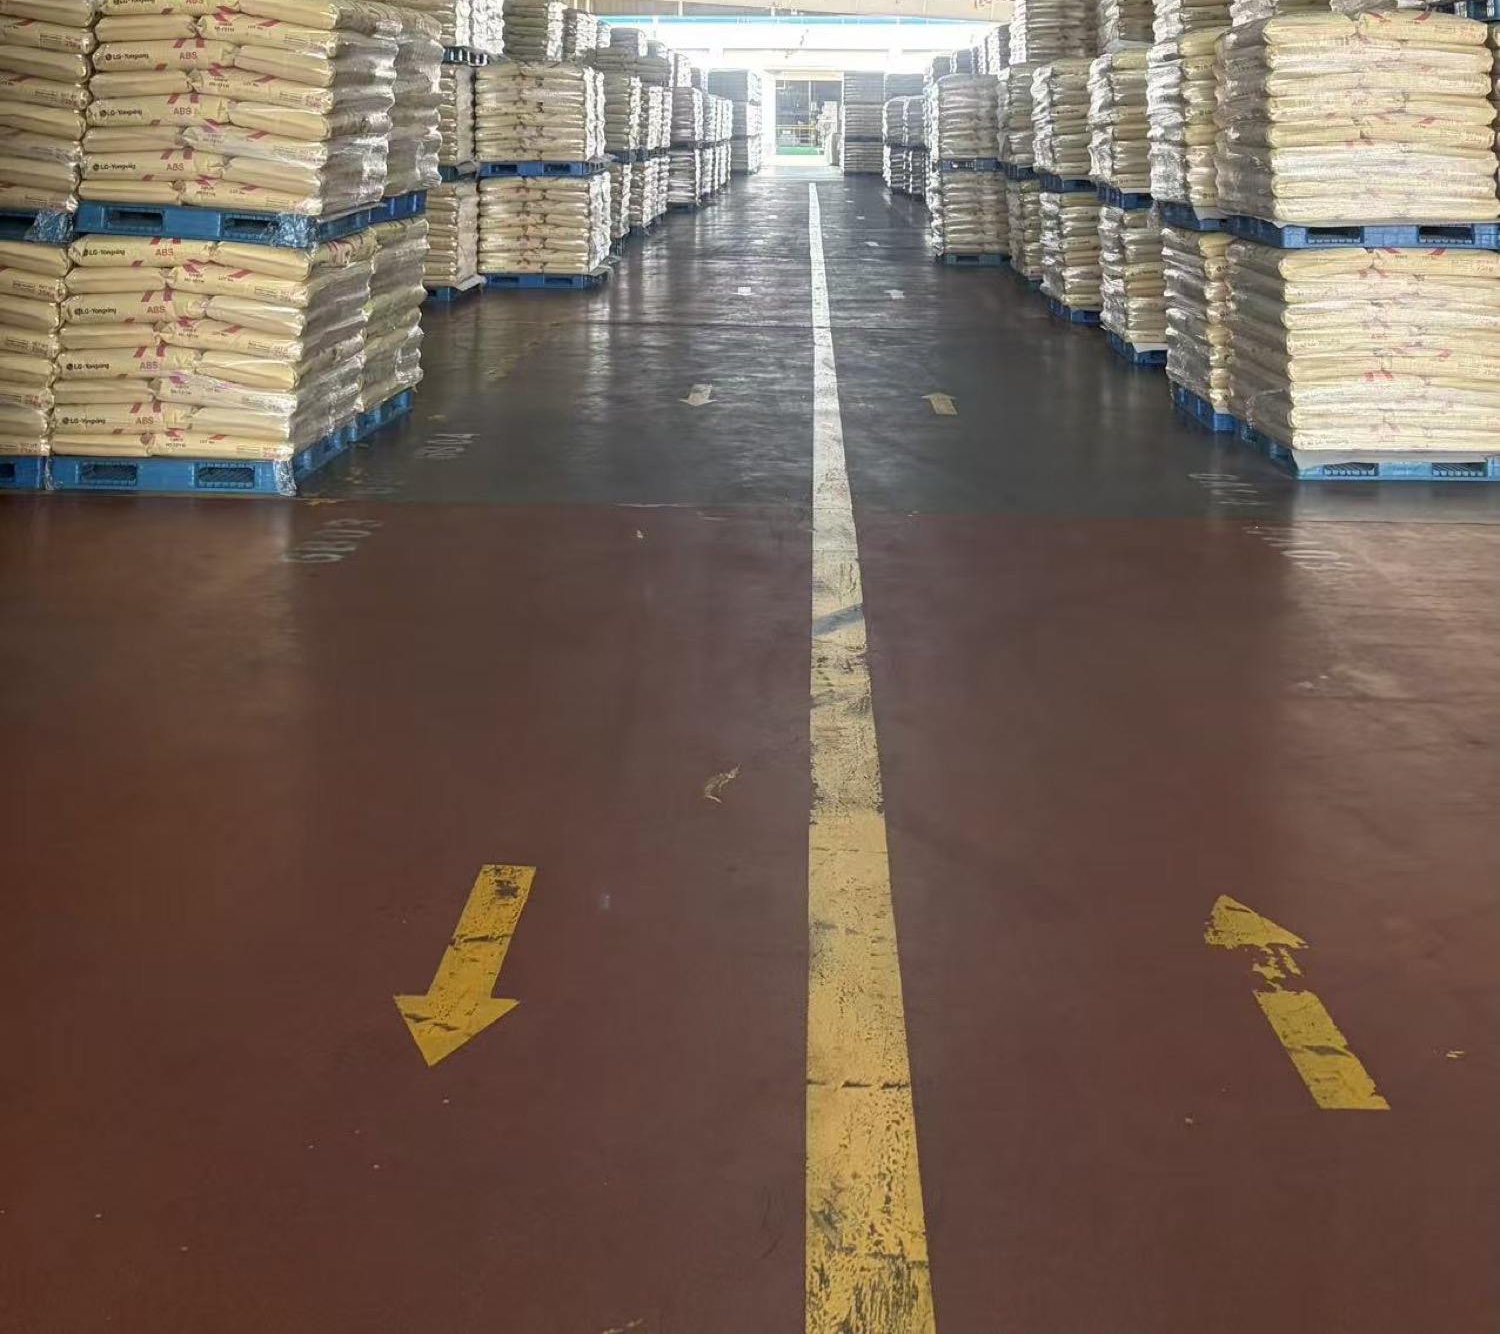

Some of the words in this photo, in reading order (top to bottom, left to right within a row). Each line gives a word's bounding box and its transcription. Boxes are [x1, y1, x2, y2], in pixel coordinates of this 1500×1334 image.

[179, 52, 198, 60] ABS
[173, 107, 192, 115] ABS
[166, 163, 184, 171] ABS
[155, 248, 174, 256] ABS
[147, 306, 166, 314] ABS
[140, 361, 159, 369] ABS
[136, 417, 154, 425] ABS
